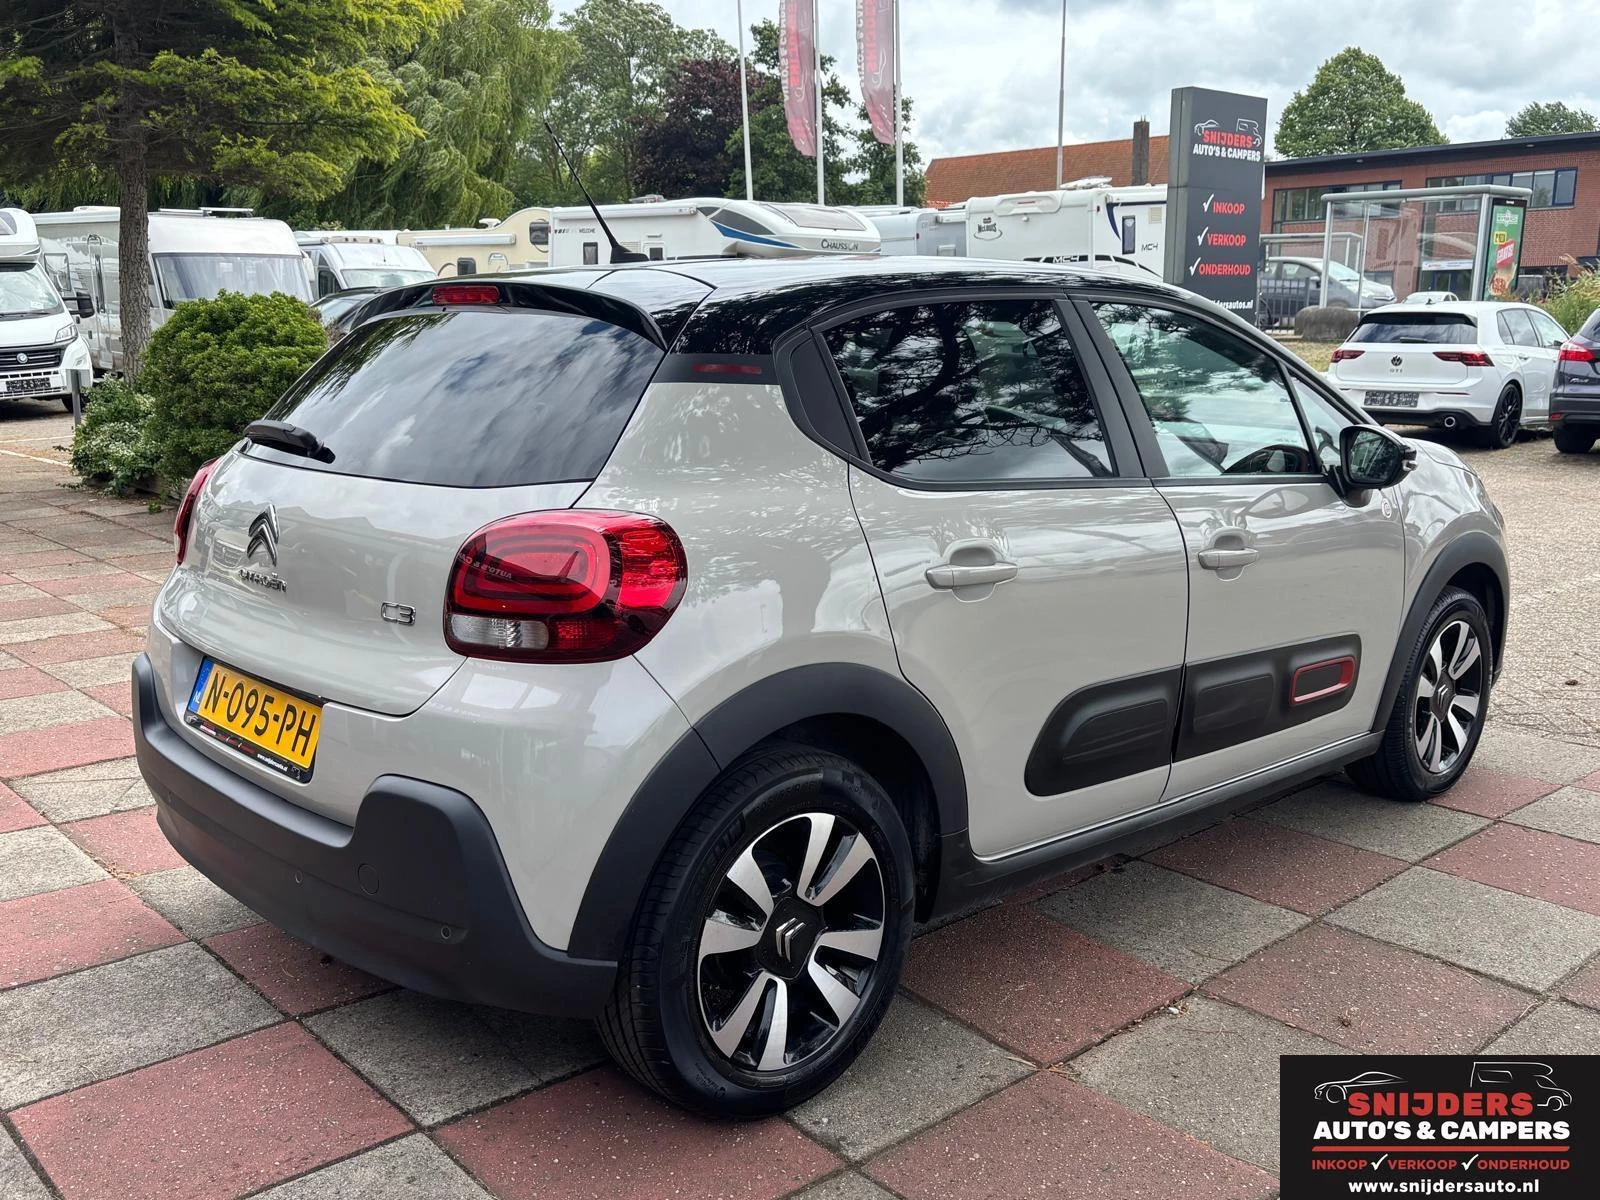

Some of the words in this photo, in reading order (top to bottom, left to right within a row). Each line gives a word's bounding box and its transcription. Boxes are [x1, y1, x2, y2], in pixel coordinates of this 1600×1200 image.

[1203, 130, 1253, 147] SNIJDERS
[1193, 144, 1220, 156] AUTO'S
[1220, 148, 1226, 158] &
[1227, 149, 1261, 162] CAMPERS
[1213, 201, 1245, 214] INKOOP
[1207, 233, 1247, 247] VERKOOP
[1199, 263, 1252, 276] ONDERHOUD
[381, 601, 416, 626] C3
[204, 671, 316, 757] N-095-PH
